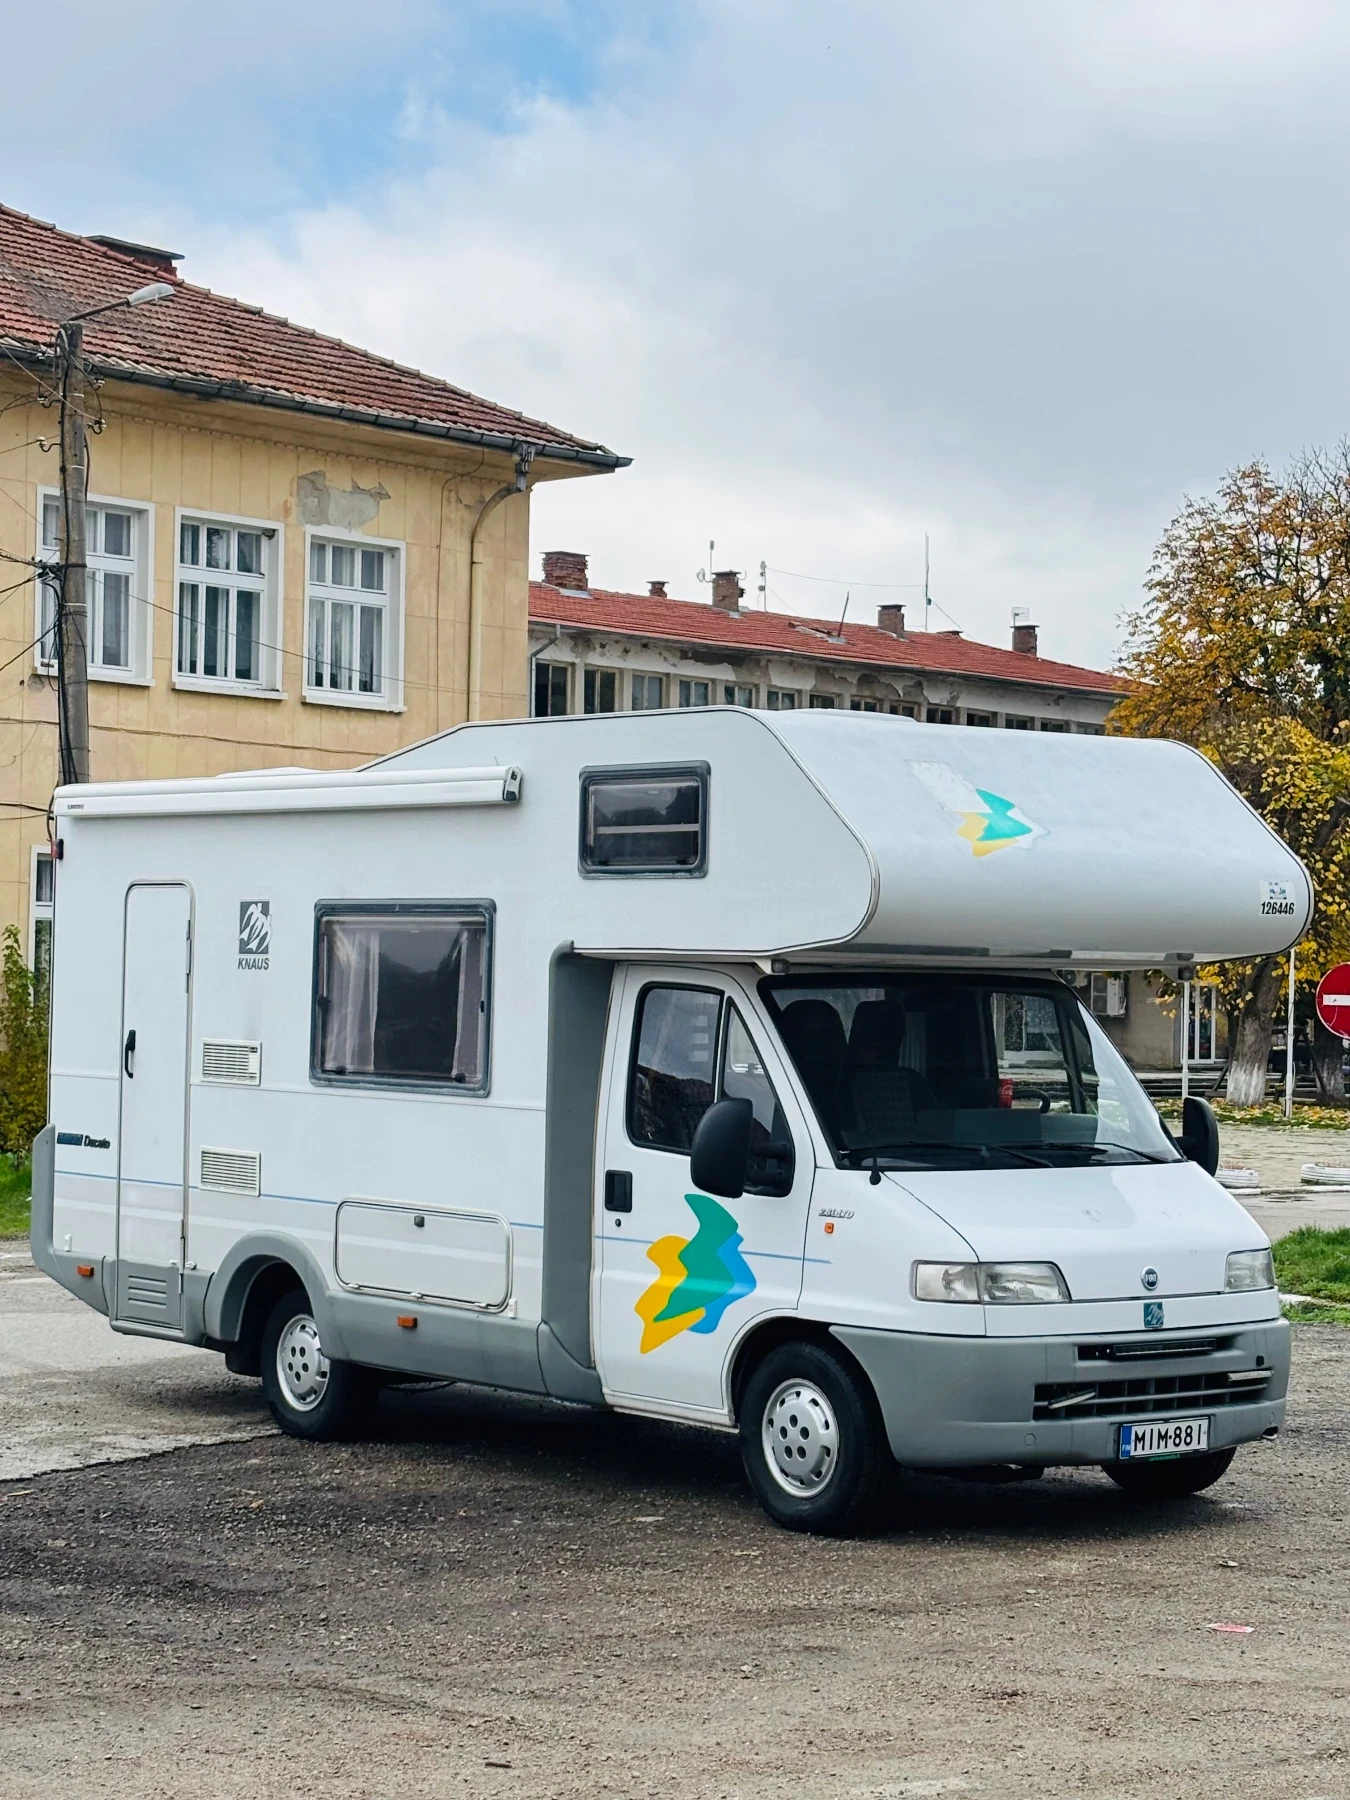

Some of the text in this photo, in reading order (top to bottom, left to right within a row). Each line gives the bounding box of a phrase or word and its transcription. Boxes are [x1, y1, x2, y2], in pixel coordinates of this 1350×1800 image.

[1261, 901, 1295, 915] 126446
[237, 957, 270, 970] KNAUS
[1134, 1423, 1202, 1452] MIM-881
